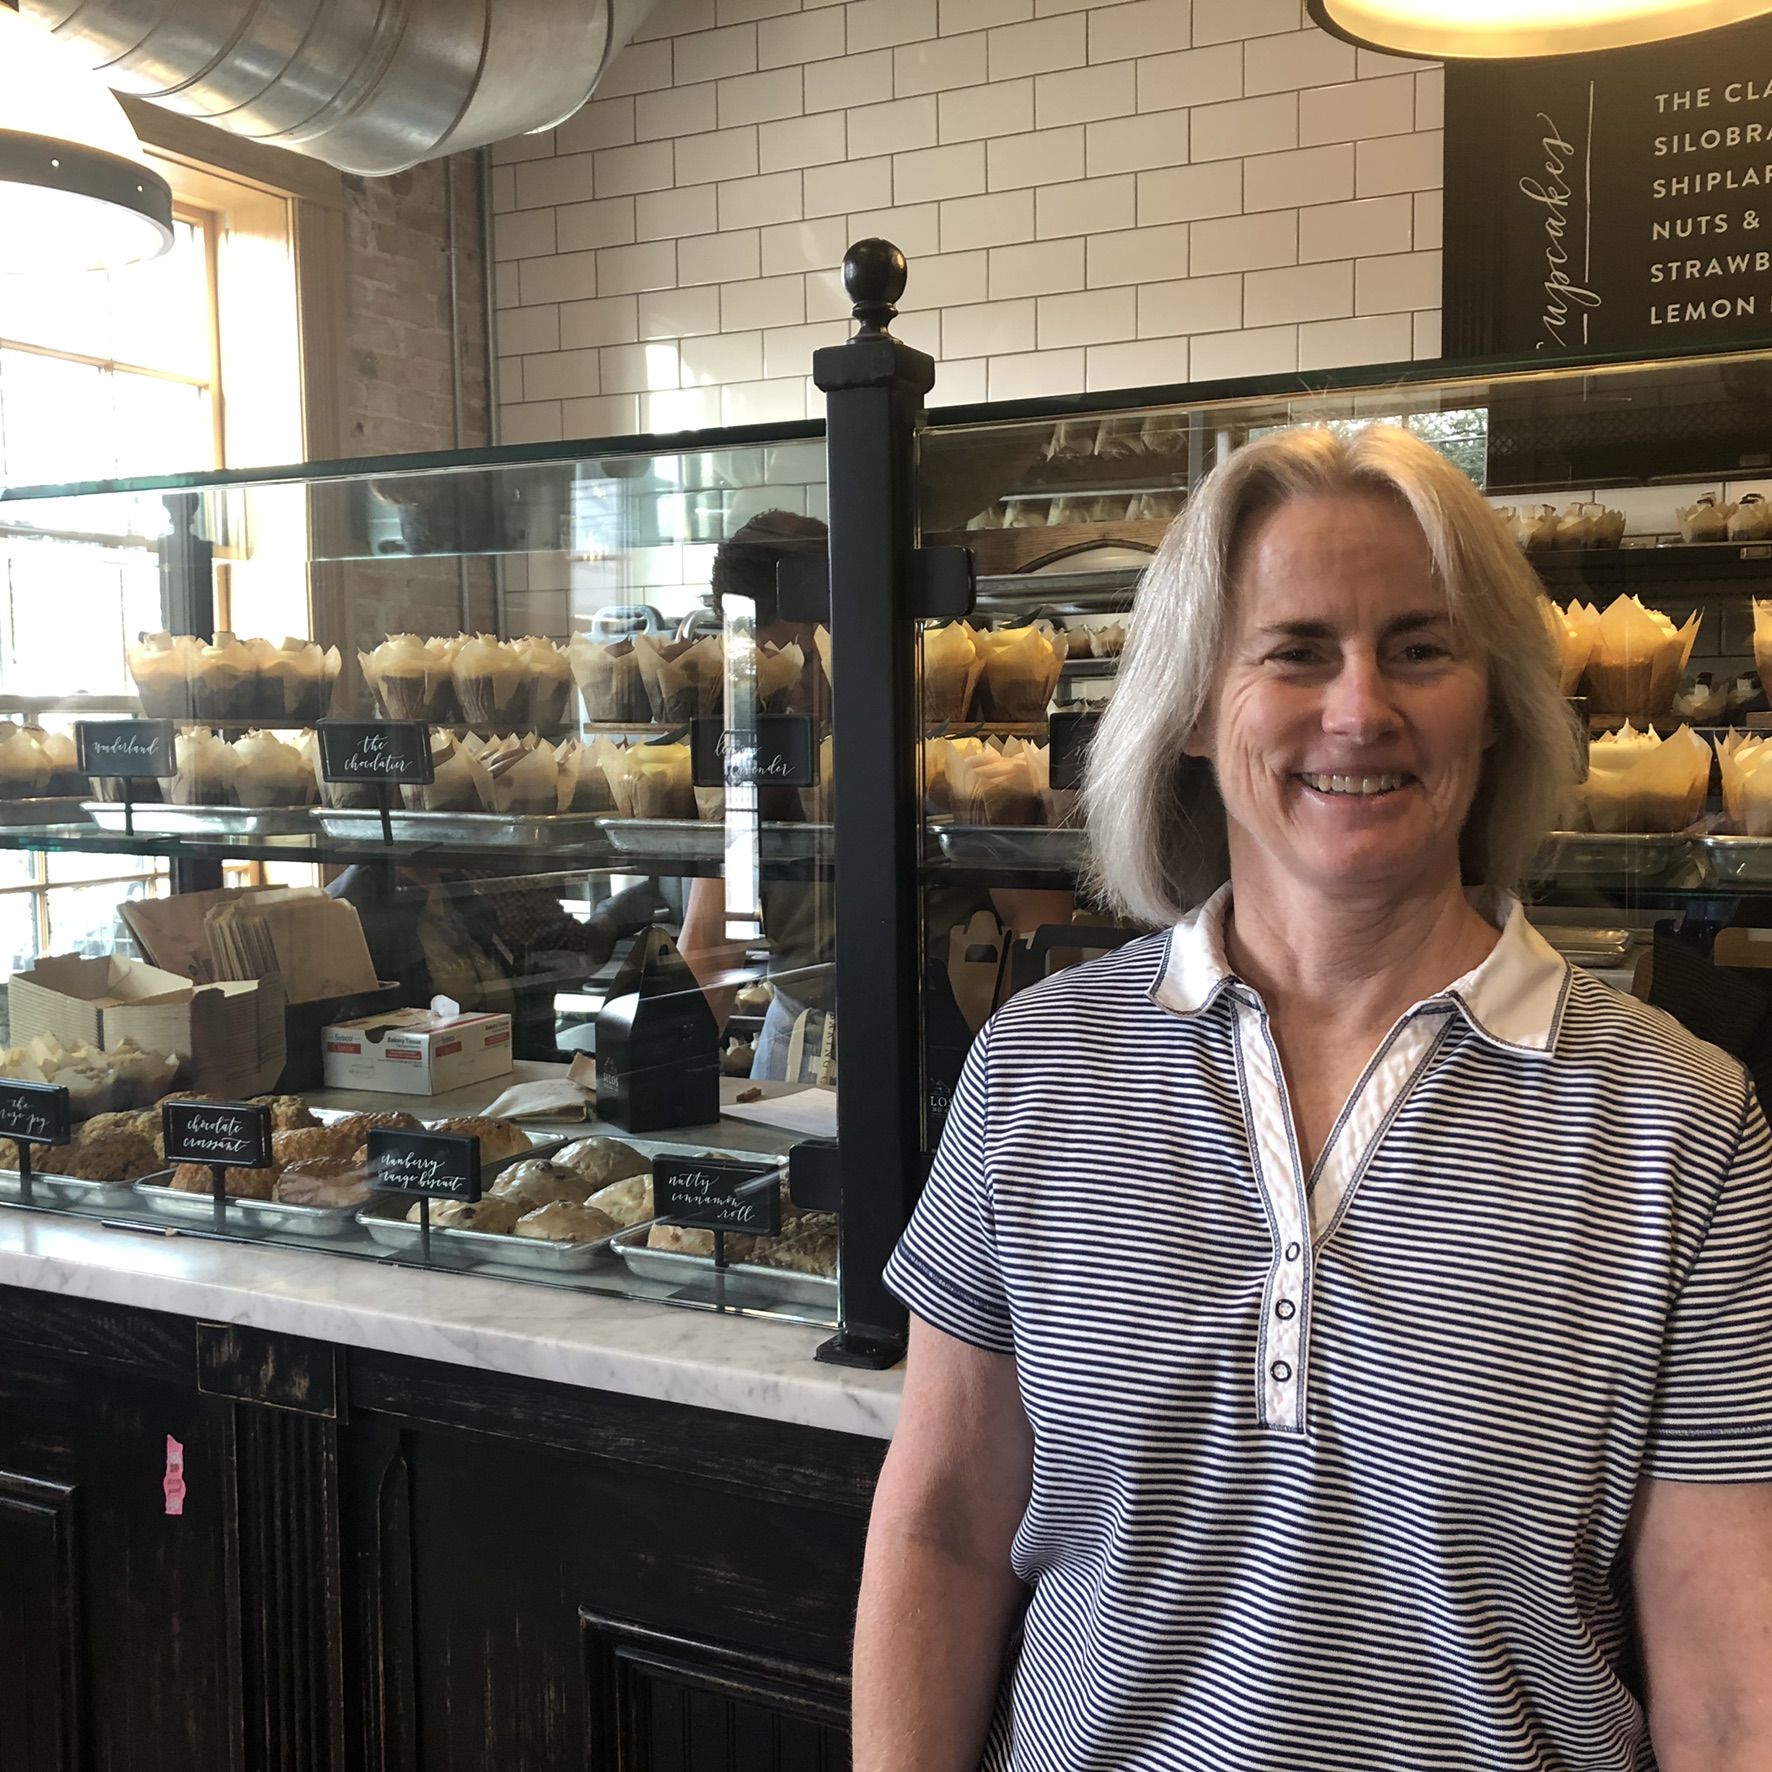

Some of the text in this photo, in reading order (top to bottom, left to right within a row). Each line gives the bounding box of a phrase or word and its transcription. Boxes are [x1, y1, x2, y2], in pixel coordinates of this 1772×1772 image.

[1655, 87, 1711, 113] THE
[1519, 111, 1602, 350] upcakes
[1652, 210, 1760, 240] NUTS &
[1650, 251, 1770, 283] STRAWB
[1650, 295, 1755, 325] LEMON
[357, 734, 389, 754] the
[344, 752, 413, 773] chocolatier
[729, 754, 796, 777] avender
[187, 1113, 243, 1136] chocolate
[183, 1137, 251, 1153] croissant
[381, 1151, 445, 1178] cranberry
[418, 1170, 466, 1192] biscuit
[668, 1171, 720, 1195] nutty
[671, 1192, 747, 1208] cinnamon
[717, 1204, 756, 1223] roll
